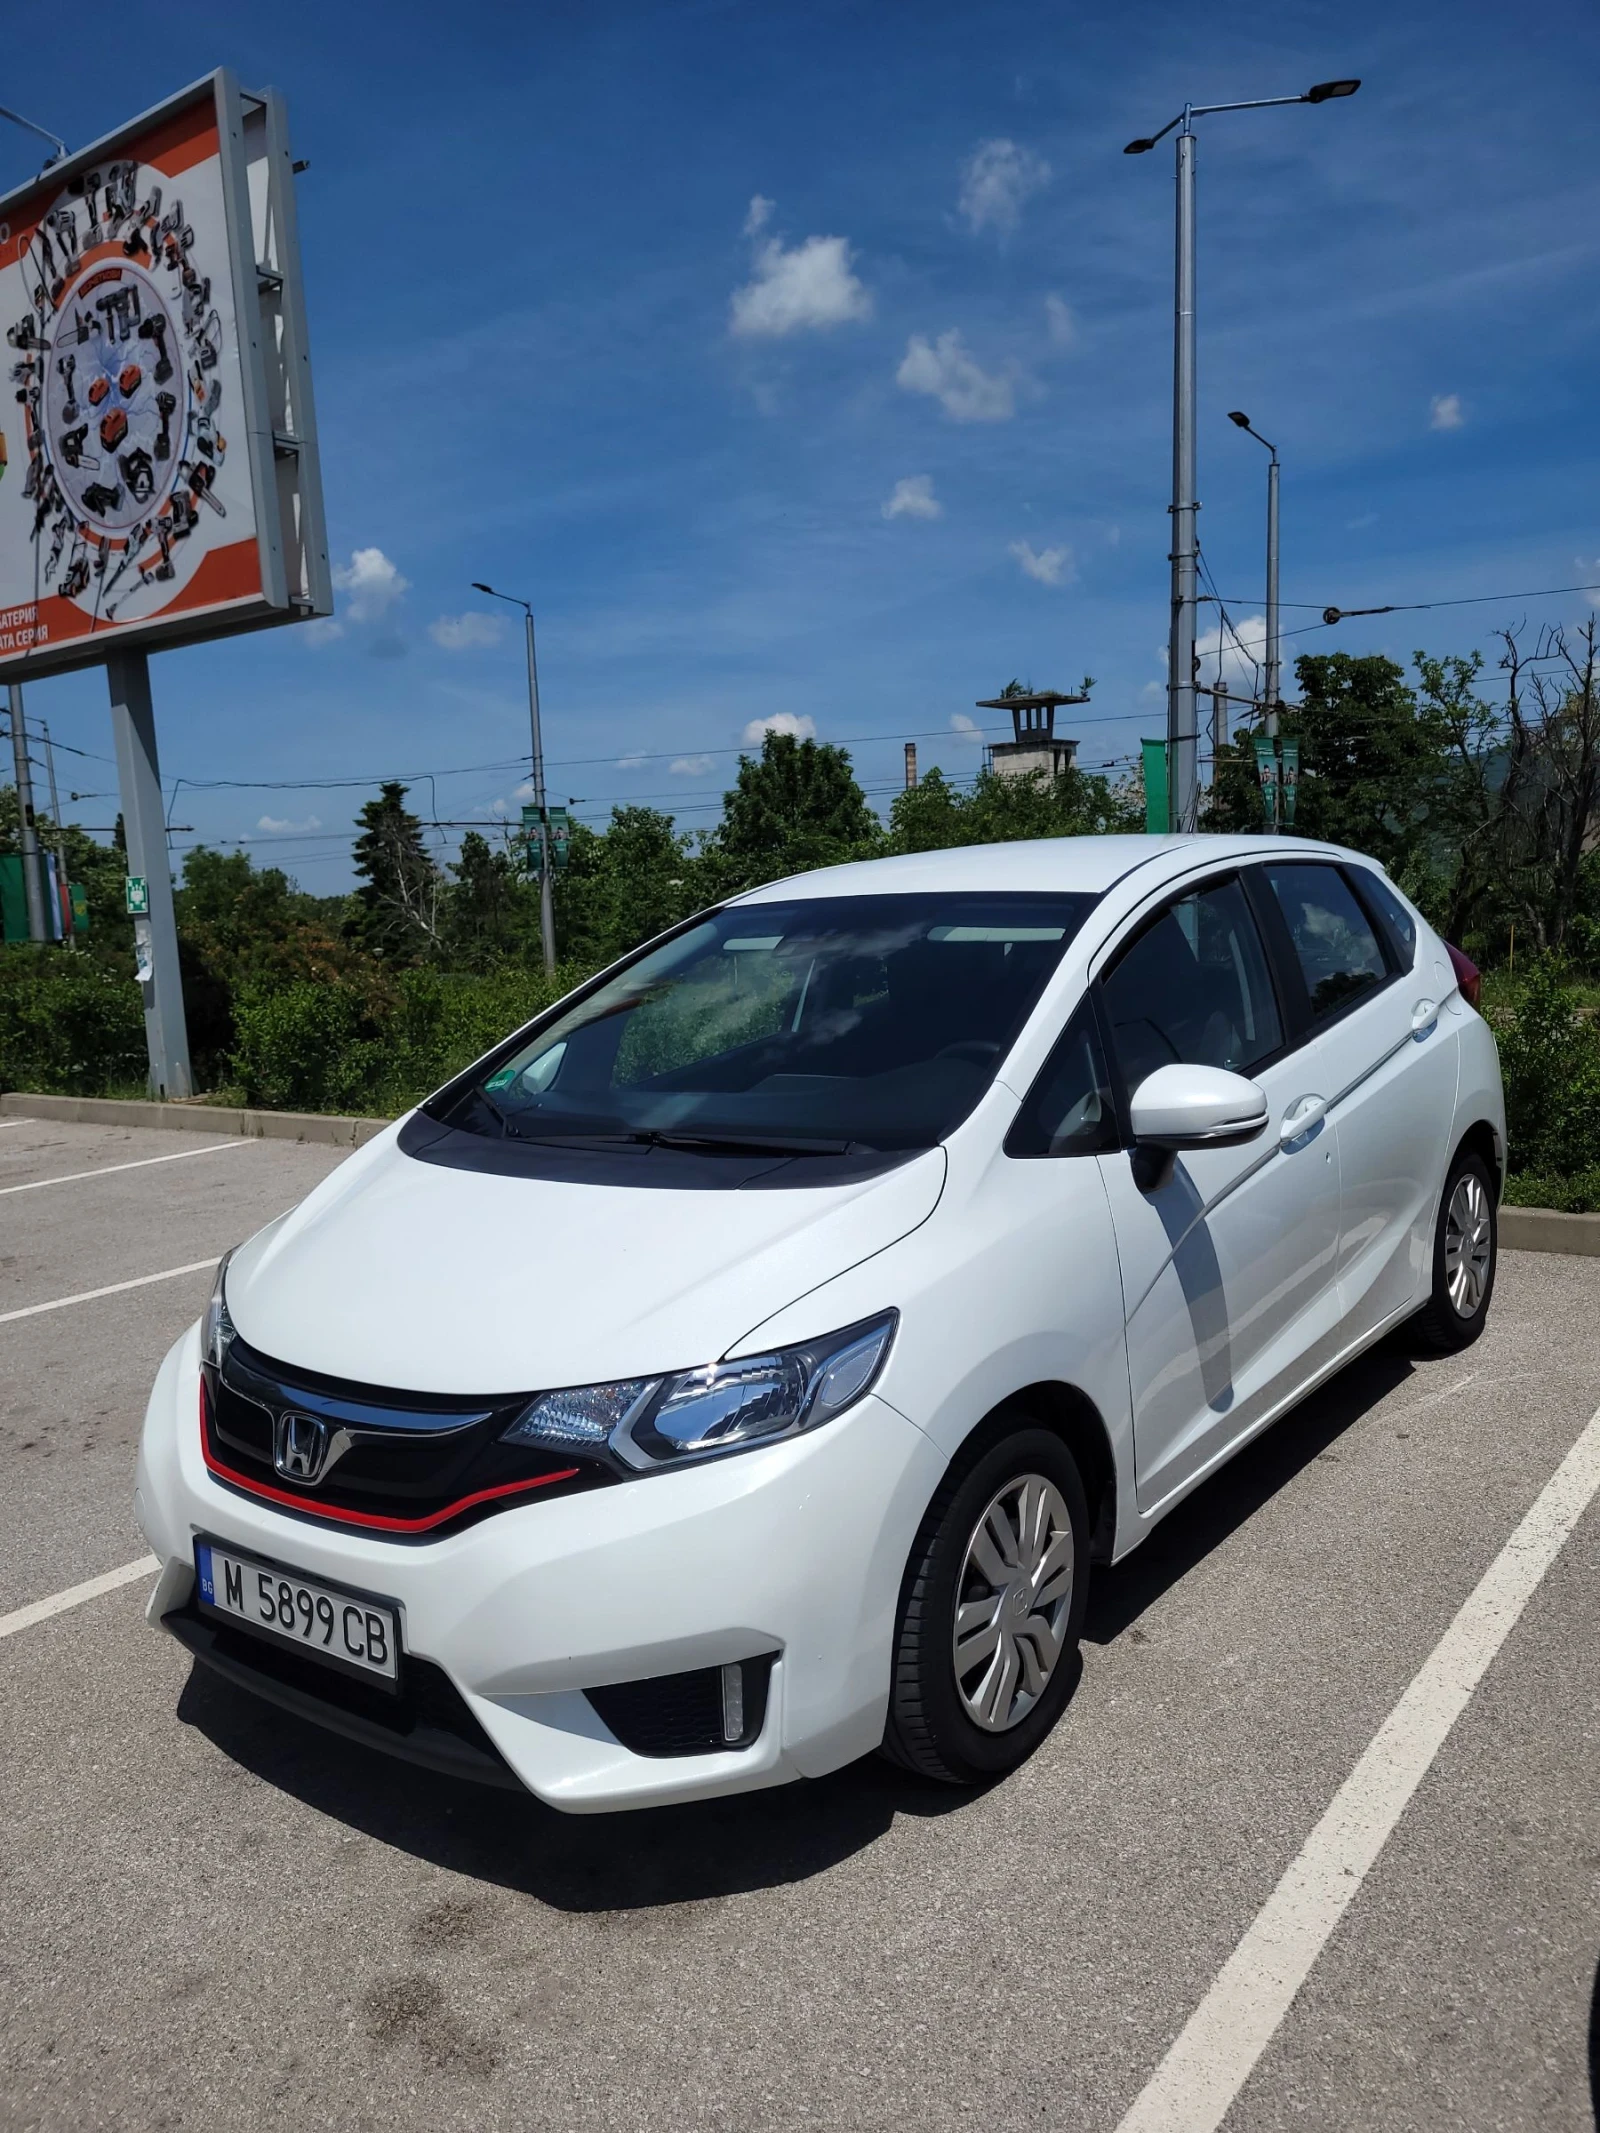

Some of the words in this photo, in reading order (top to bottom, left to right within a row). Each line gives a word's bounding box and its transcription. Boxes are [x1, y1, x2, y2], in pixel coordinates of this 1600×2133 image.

[0, 606, 38, 630] АТЕРИЯ
[15, 624, 48, 646] СЕРИЯ
[202, 1578, 213, 1595] BG
[224, 1558, 244, 1612] M
[257, 1572, 335, 1645] 5899
[342, 1605, 388, 1665] CB
